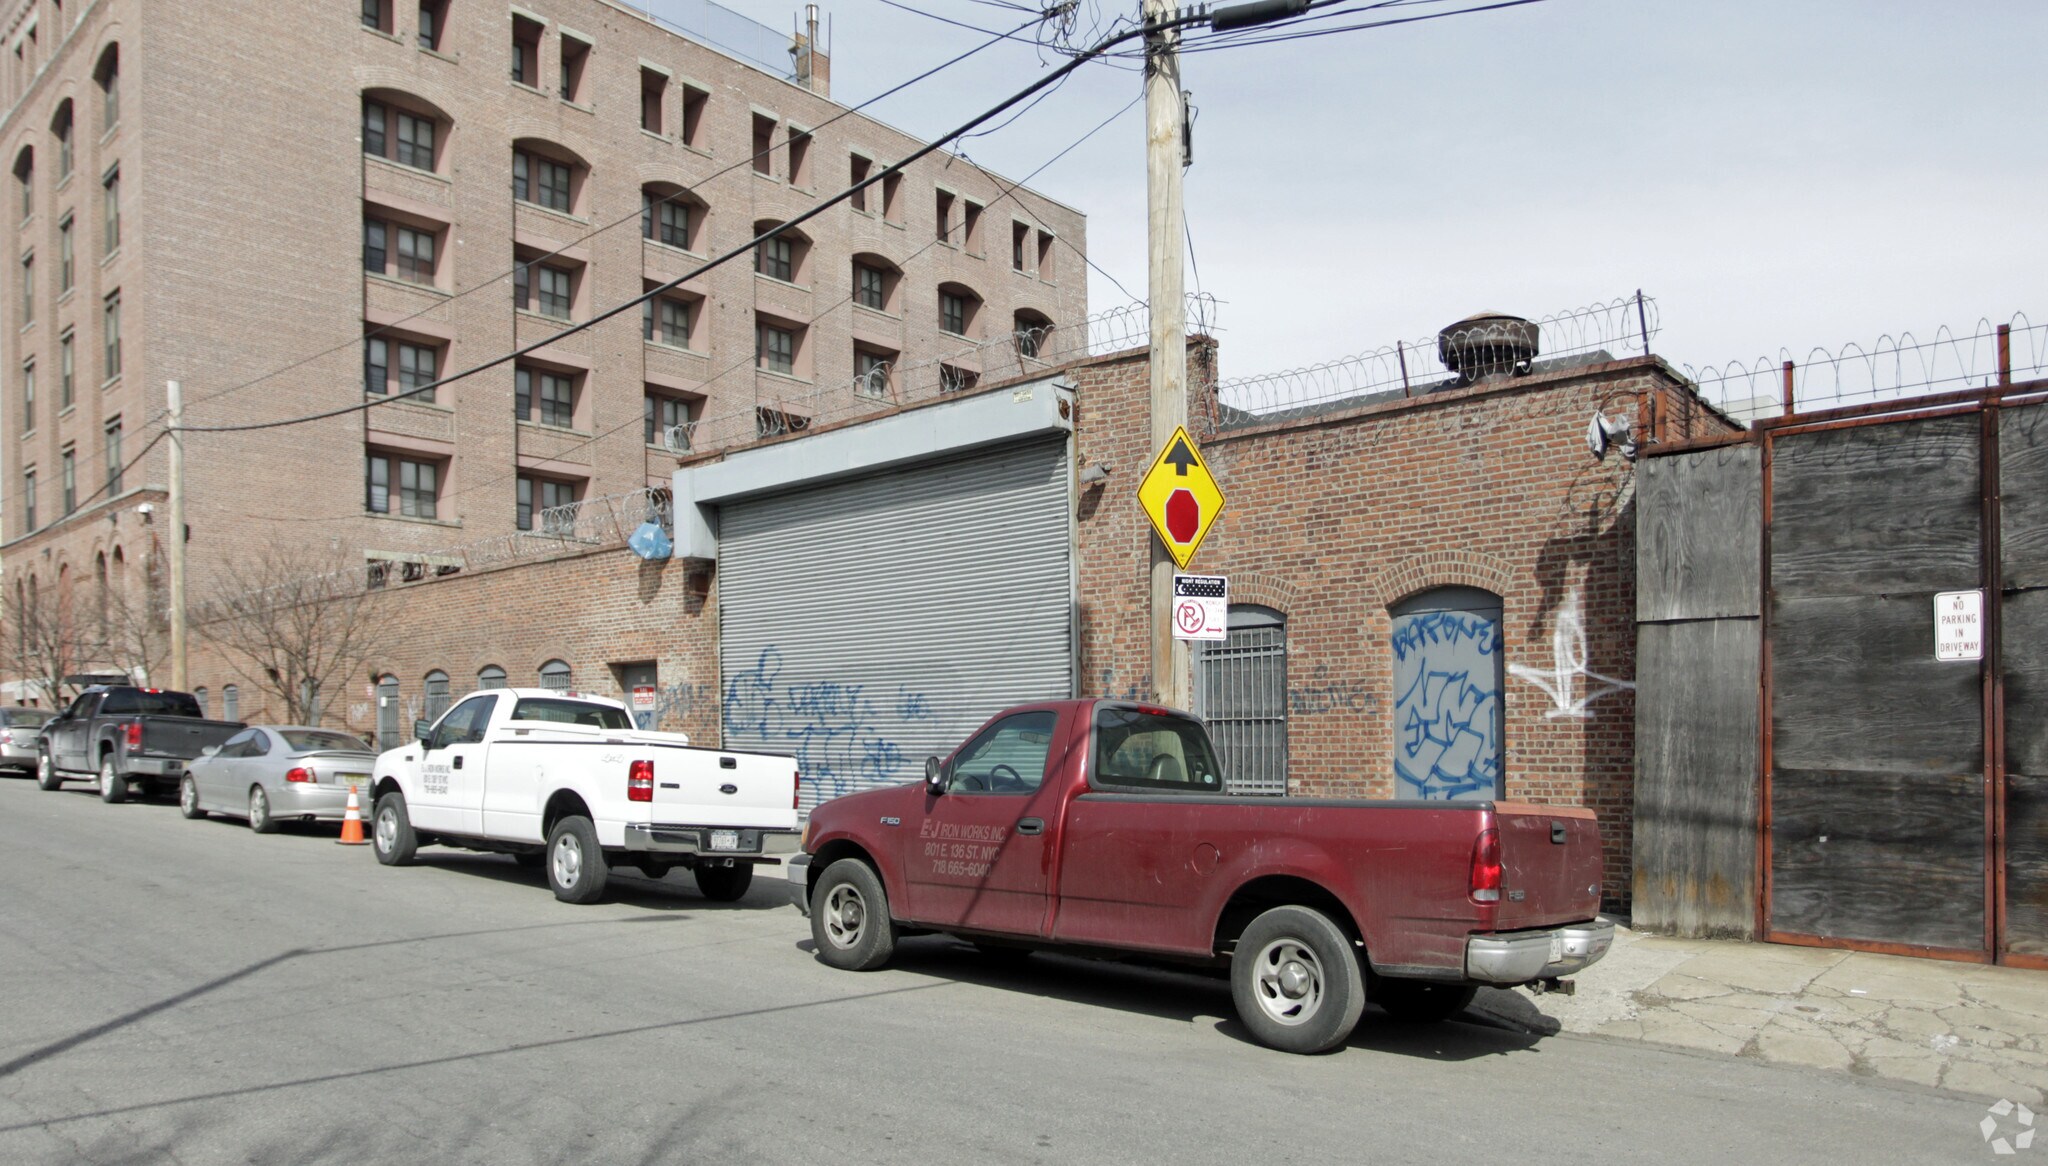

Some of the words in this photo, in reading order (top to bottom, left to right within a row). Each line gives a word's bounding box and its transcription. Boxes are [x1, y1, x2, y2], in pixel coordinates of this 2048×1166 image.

[1953, 600, 1964, 610] NO
[1941, 613, 1977, 624] PARKING
[1955, 628, 1964, 638] IN
[1940, 641, 1979, 653] DRIVEWAY
[940, 823, 960, 838] IRON
[960, 824, 990, 840] WORKS
[924, 841, 940, 856] 801
[950, 844, 965, 858] 136
[981, 847, 1000, 861] NYC
[932, 859, 947, 873] 718
[947, 860, 992, 877] 665-6040
